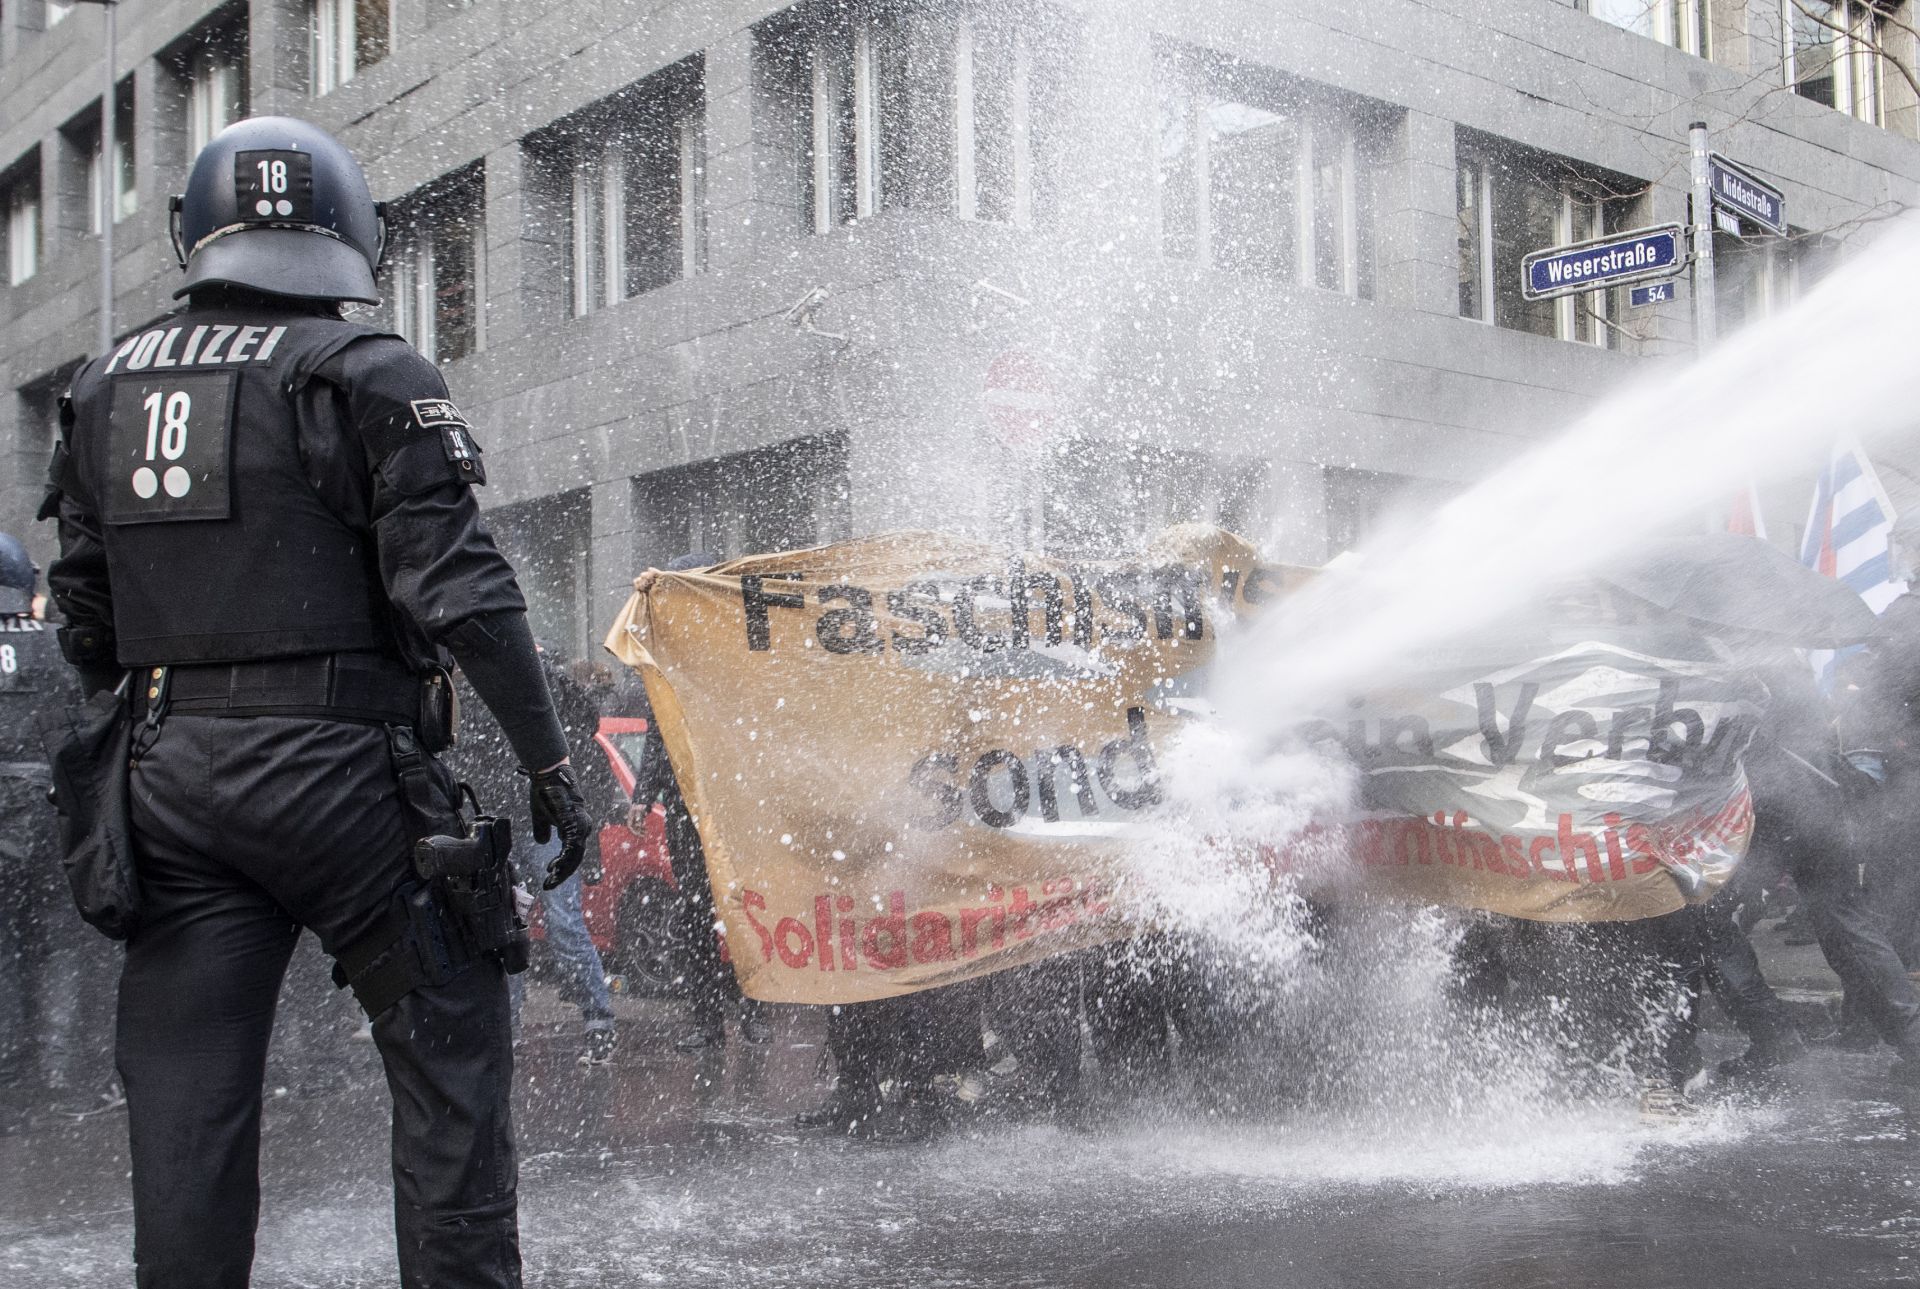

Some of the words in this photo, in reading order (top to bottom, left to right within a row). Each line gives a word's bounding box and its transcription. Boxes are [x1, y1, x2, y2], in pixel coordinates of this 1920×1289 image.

[257, 160, 287, 193] 18
[1722, 172, 1772, 218] Niddastraße
[1548, 242, 1656, 283] Weserstraße
[1648, 285, 1666, 302] 54
[104, 325, 288, 374] POLIZEI
[143, 391, 191, 461] 18
[449, 431, 464, 448] 18
[0, 643, 17, 674] 8
